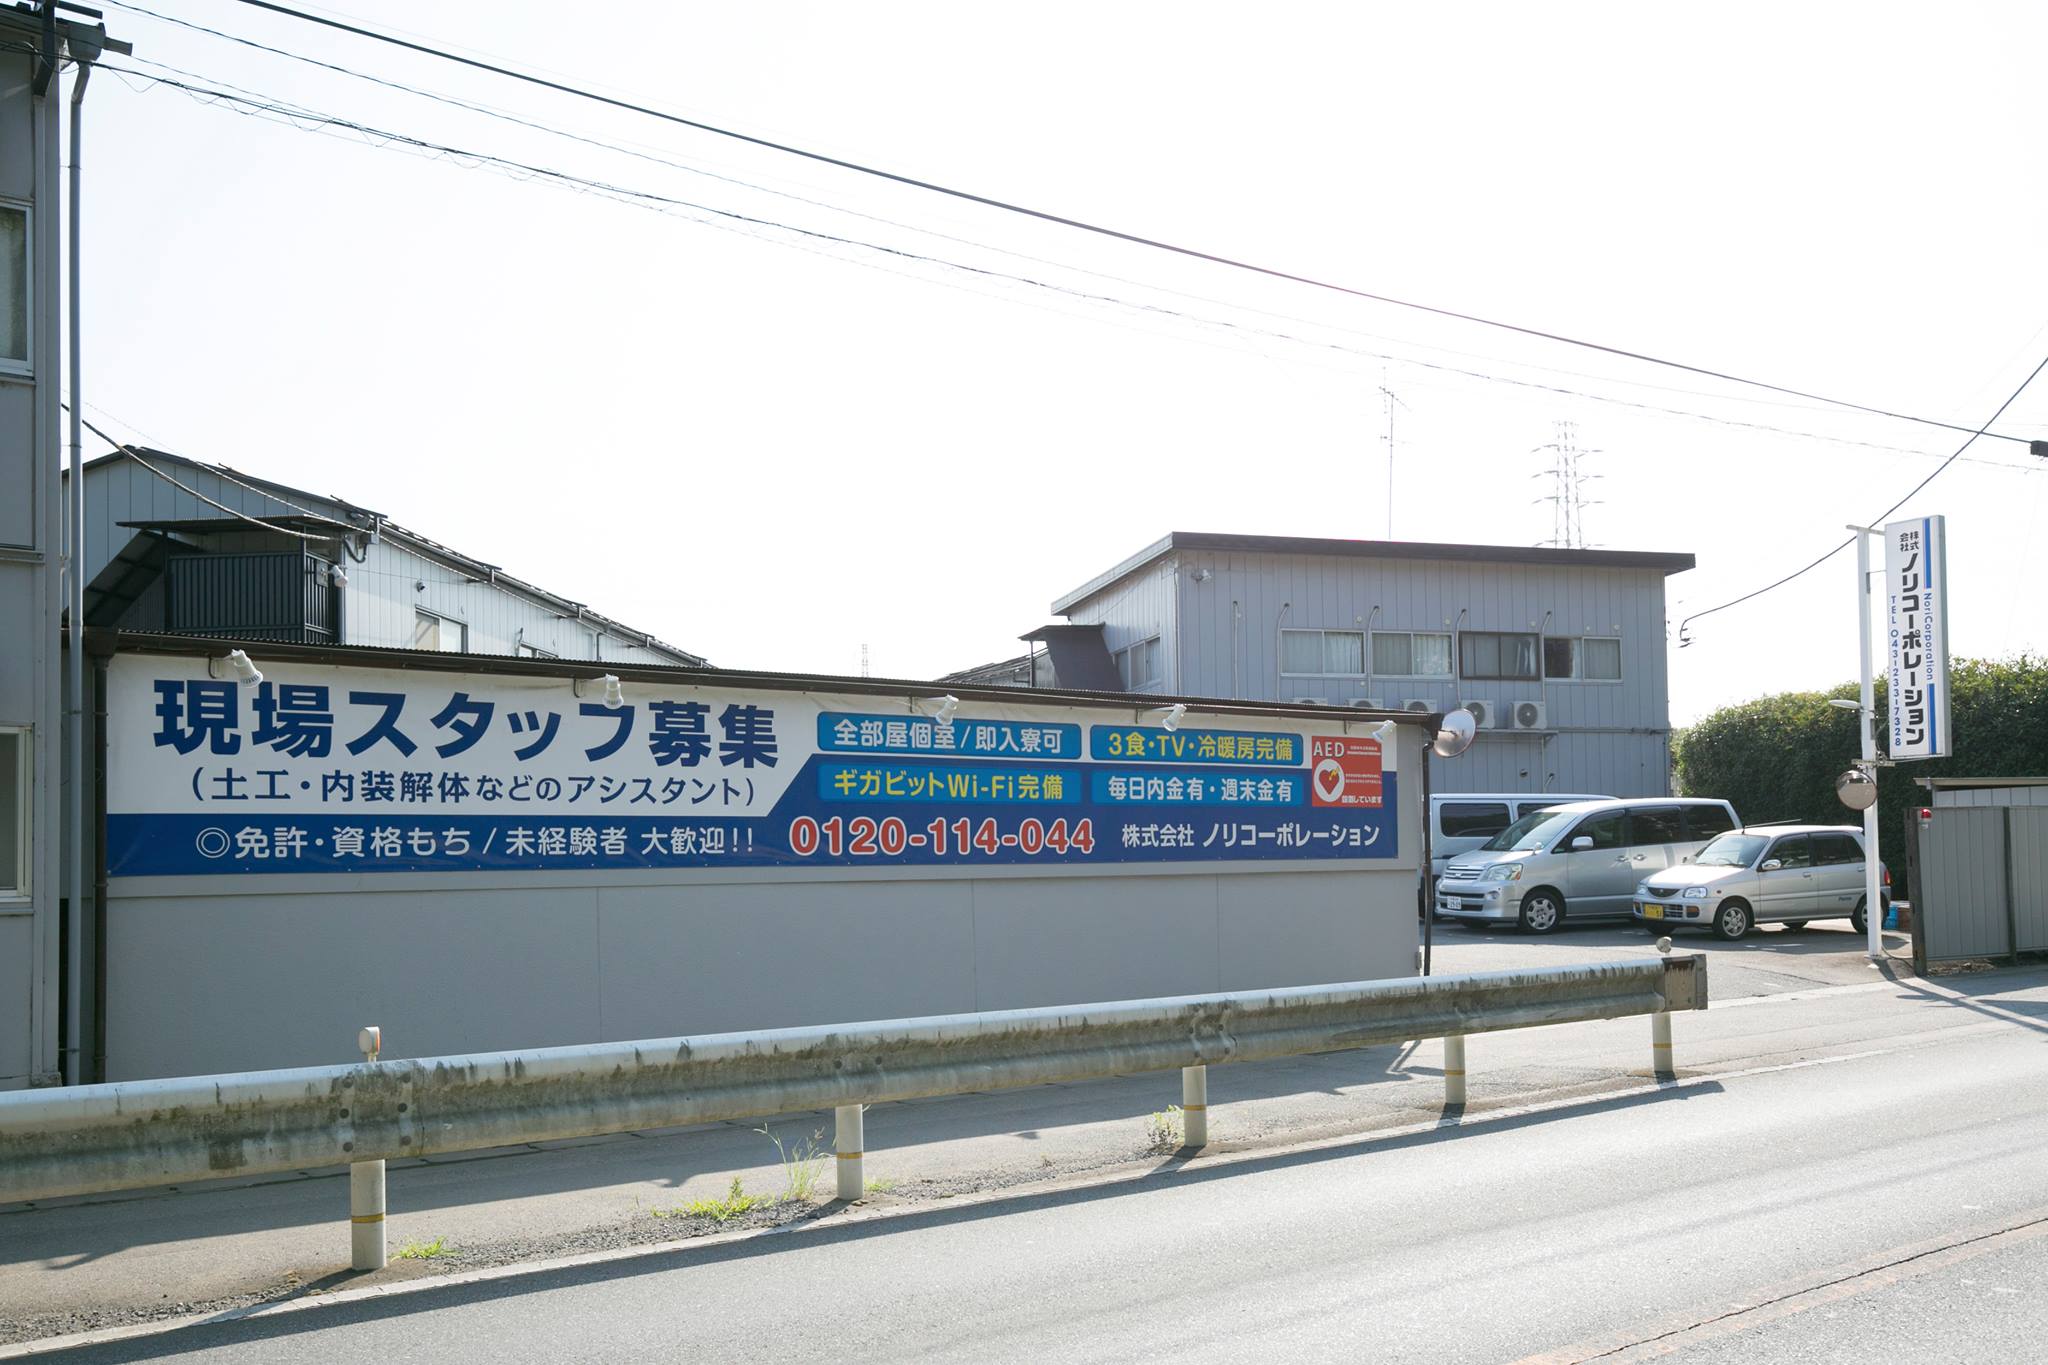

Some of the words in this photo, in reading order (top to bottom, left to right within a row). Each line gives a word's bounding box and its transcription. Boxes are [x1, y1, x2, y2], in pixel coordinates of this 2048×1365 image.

[1901, 552, 1924, 746] ノリコーポレーション
[153, 679, 778, 768] 現場スタッフ募集
[1313, 741, 1345, 757] AED
[833, 768, 1063, 800] ギガビットWi-Fi完備
[1107, 775, 1293, 802] 毎日内金有・週末金有
[789, 815, 1095, 856] 0120-114-044
[1121, 823, 1195, 848] 株式会社
[1202, 823, 1380, 847] ノリコーポレーション
